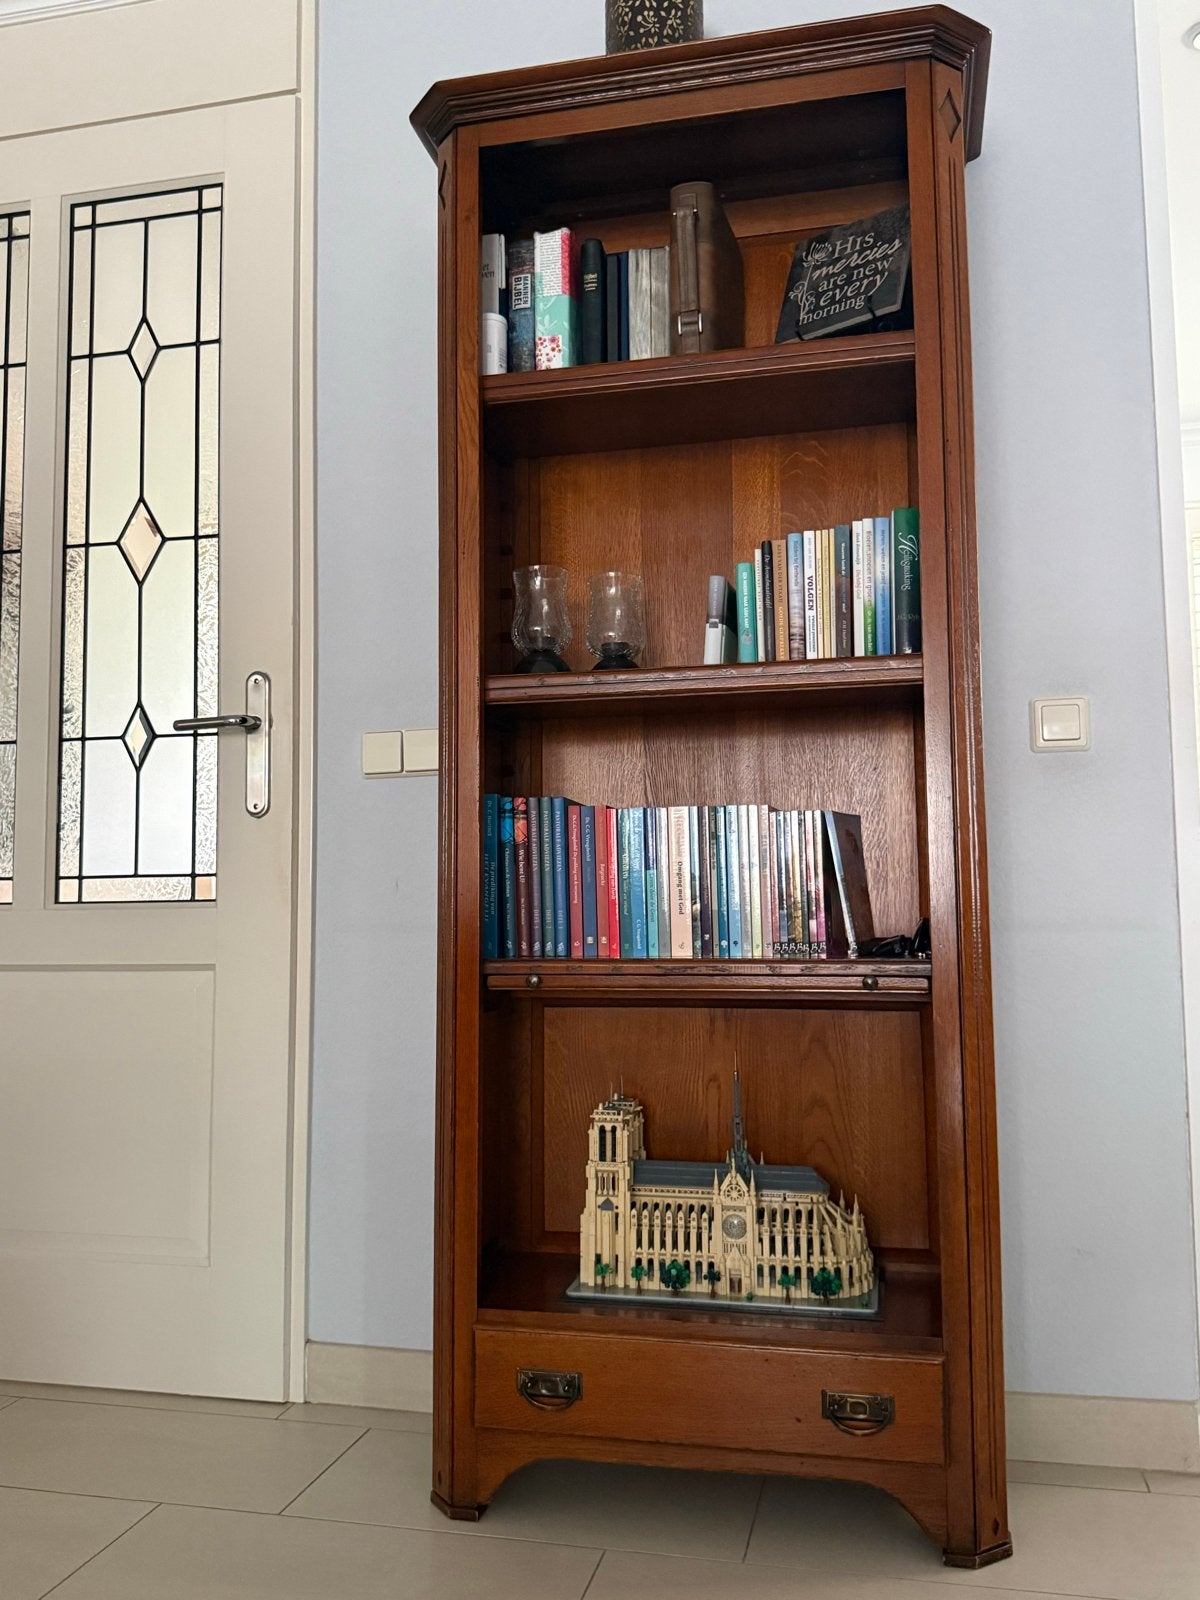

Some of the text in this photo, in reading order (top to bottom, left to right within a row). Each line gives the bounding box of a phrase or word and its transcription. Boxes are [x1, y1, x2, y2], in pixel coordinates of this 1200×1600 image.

[812, 239, 902, 280] mercies
[818, 257, 893, 292] are new
[513, 276, 522, 309] BIJBEL
[819, 272, 888, 307] every
[799, 295, 866, 326] morning
[898, 532, 918, 592] Heiligmaking
[807, 575, 815, 611] VOLGEN
[676, 861, 684, 888] Omgang
